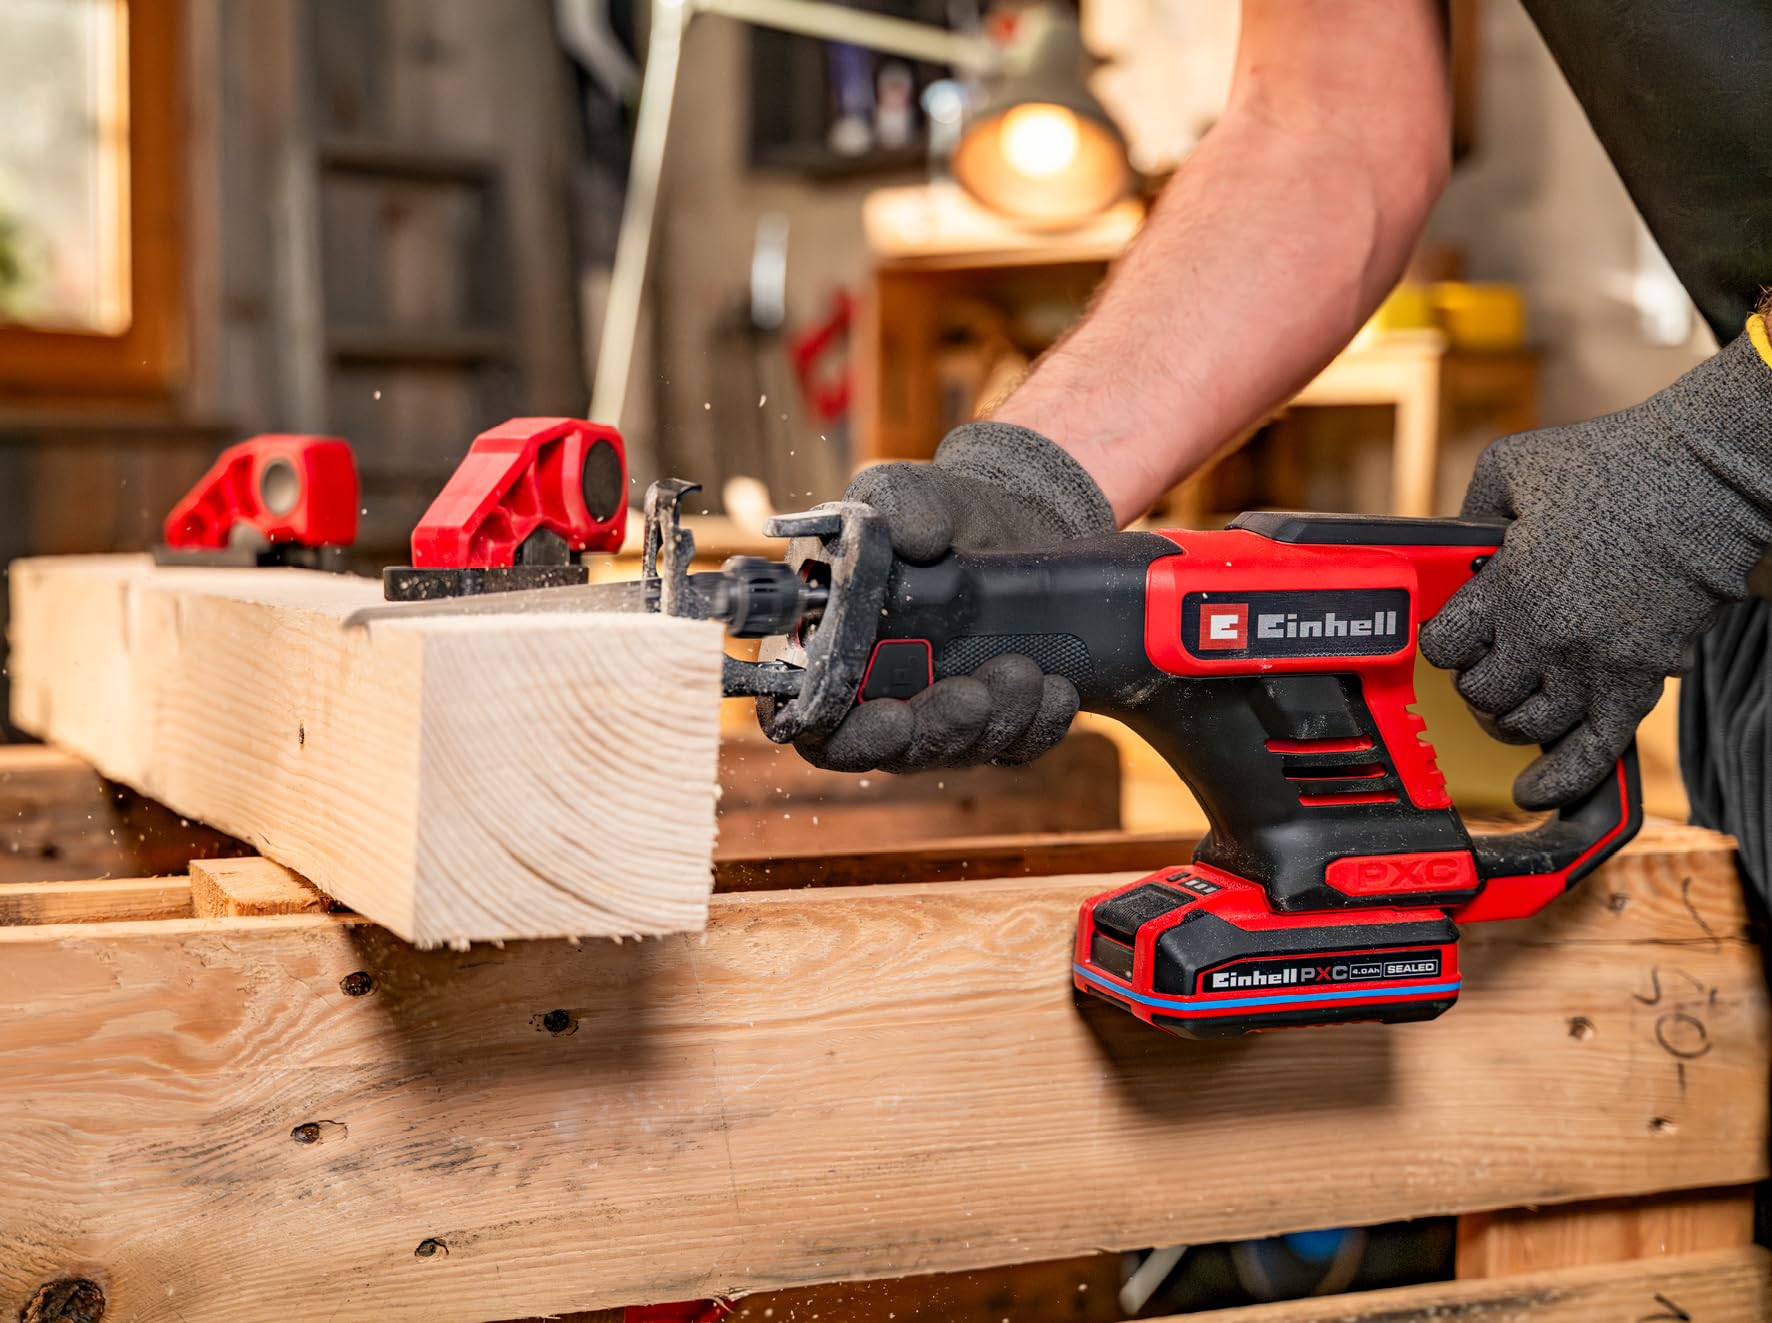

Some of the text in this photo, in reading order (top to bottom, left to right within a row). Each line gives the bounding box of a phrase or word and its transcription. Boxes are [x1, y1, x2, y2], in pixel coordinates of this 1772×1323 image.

[1257, 611, 1397, 639] Einhell
[1357, 858, 1458, 889] PXC
[1212, 963, 1435, 988] Einhell PXC 4.0Ah SEALED
